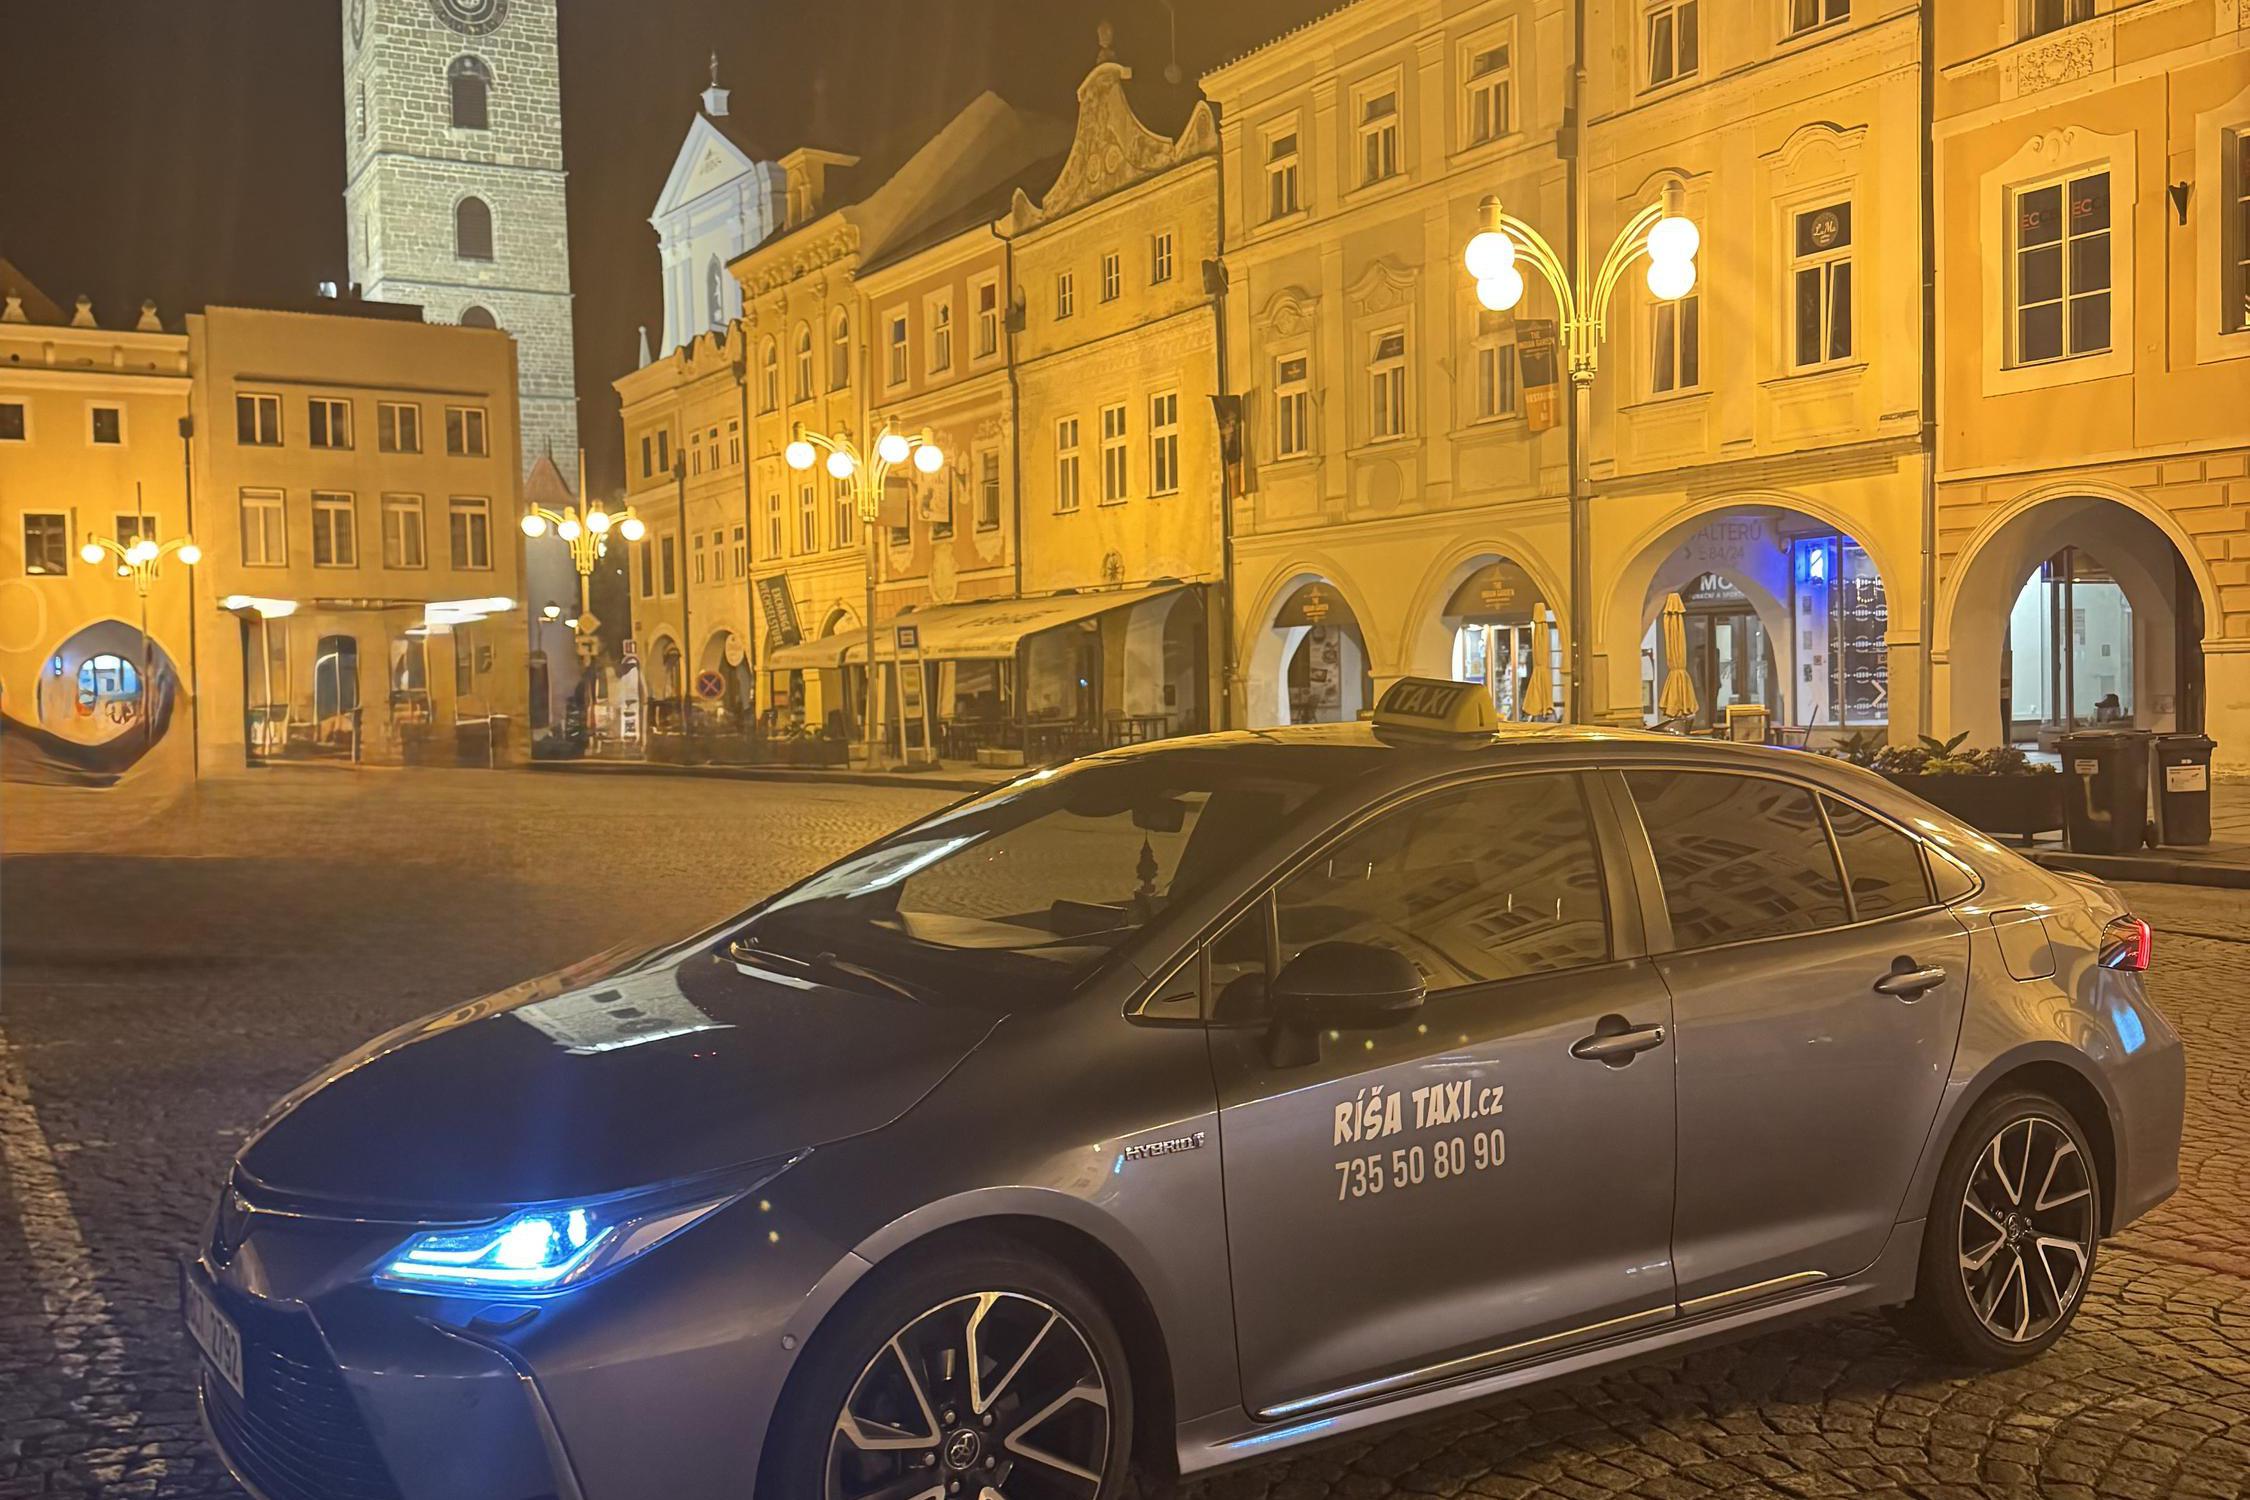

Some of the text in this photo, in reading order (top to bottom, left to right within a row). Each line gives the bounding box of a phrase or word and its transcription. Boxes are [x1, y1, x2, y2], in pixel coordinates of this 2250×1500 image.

[759, 580, 784, 647] WECHSELSTUBE
[771, 587, 792, 632] EXCHANGE
[1393, 683, 1459, 716] TAXI
[1412, 1079, 1504, 1130] TAXI.cz
[1125, 1137, 1196, 1161] HYBRID
[1335, 1128, 1505, 1201] 735 50 80 90
